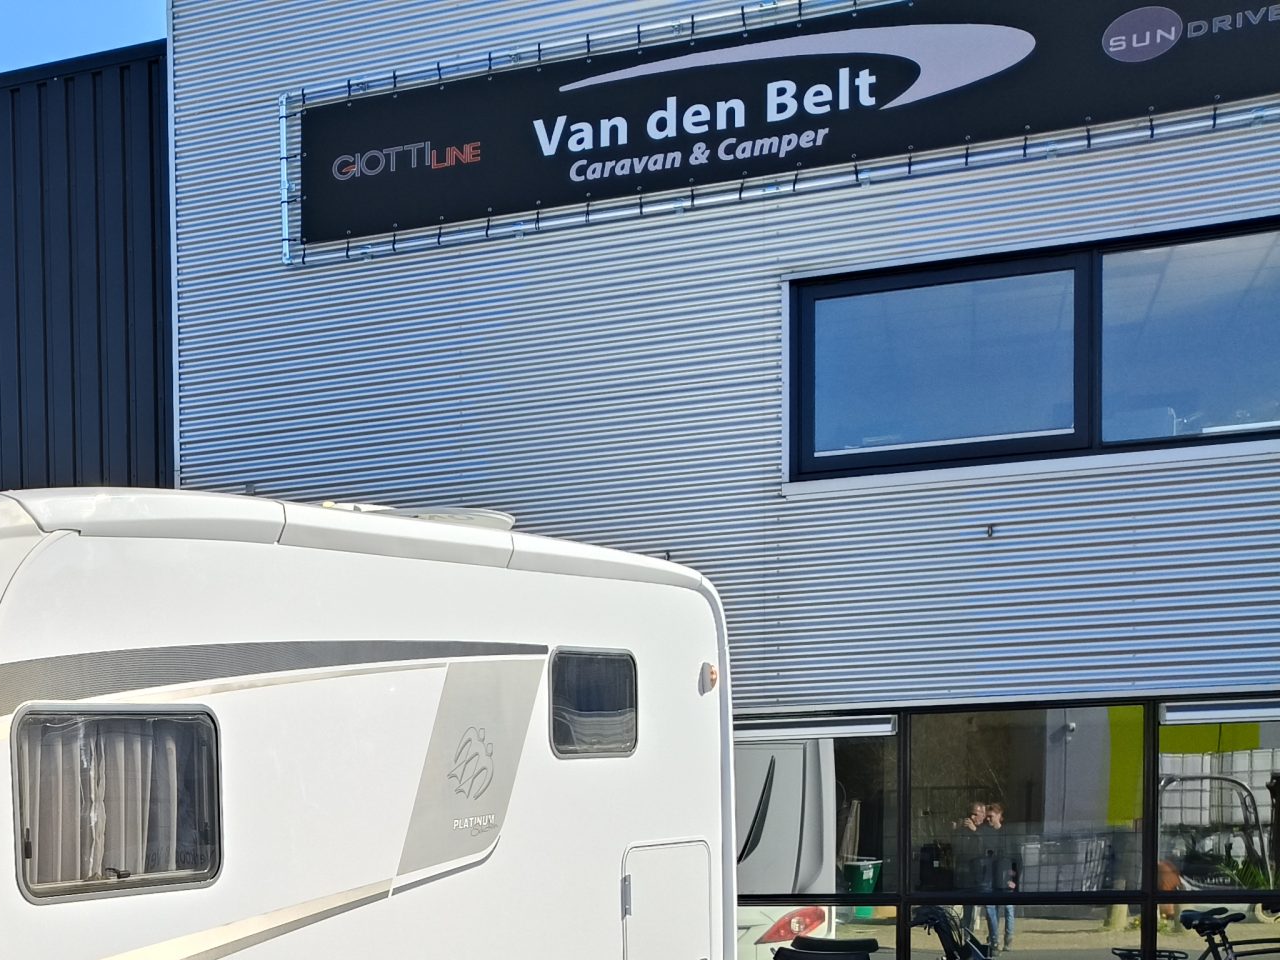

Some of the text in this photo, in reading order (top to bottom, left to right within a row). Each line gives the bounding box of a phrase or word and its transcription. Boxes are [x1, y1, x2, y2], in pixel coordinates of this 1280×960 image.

[1109, 26, 1176, 52] SUN
[533, 67, 877, 156] Van den Belt
[569, 126, 830, 182] Caravan & Camper
[453, 814, 495, 830] PLATINUM
